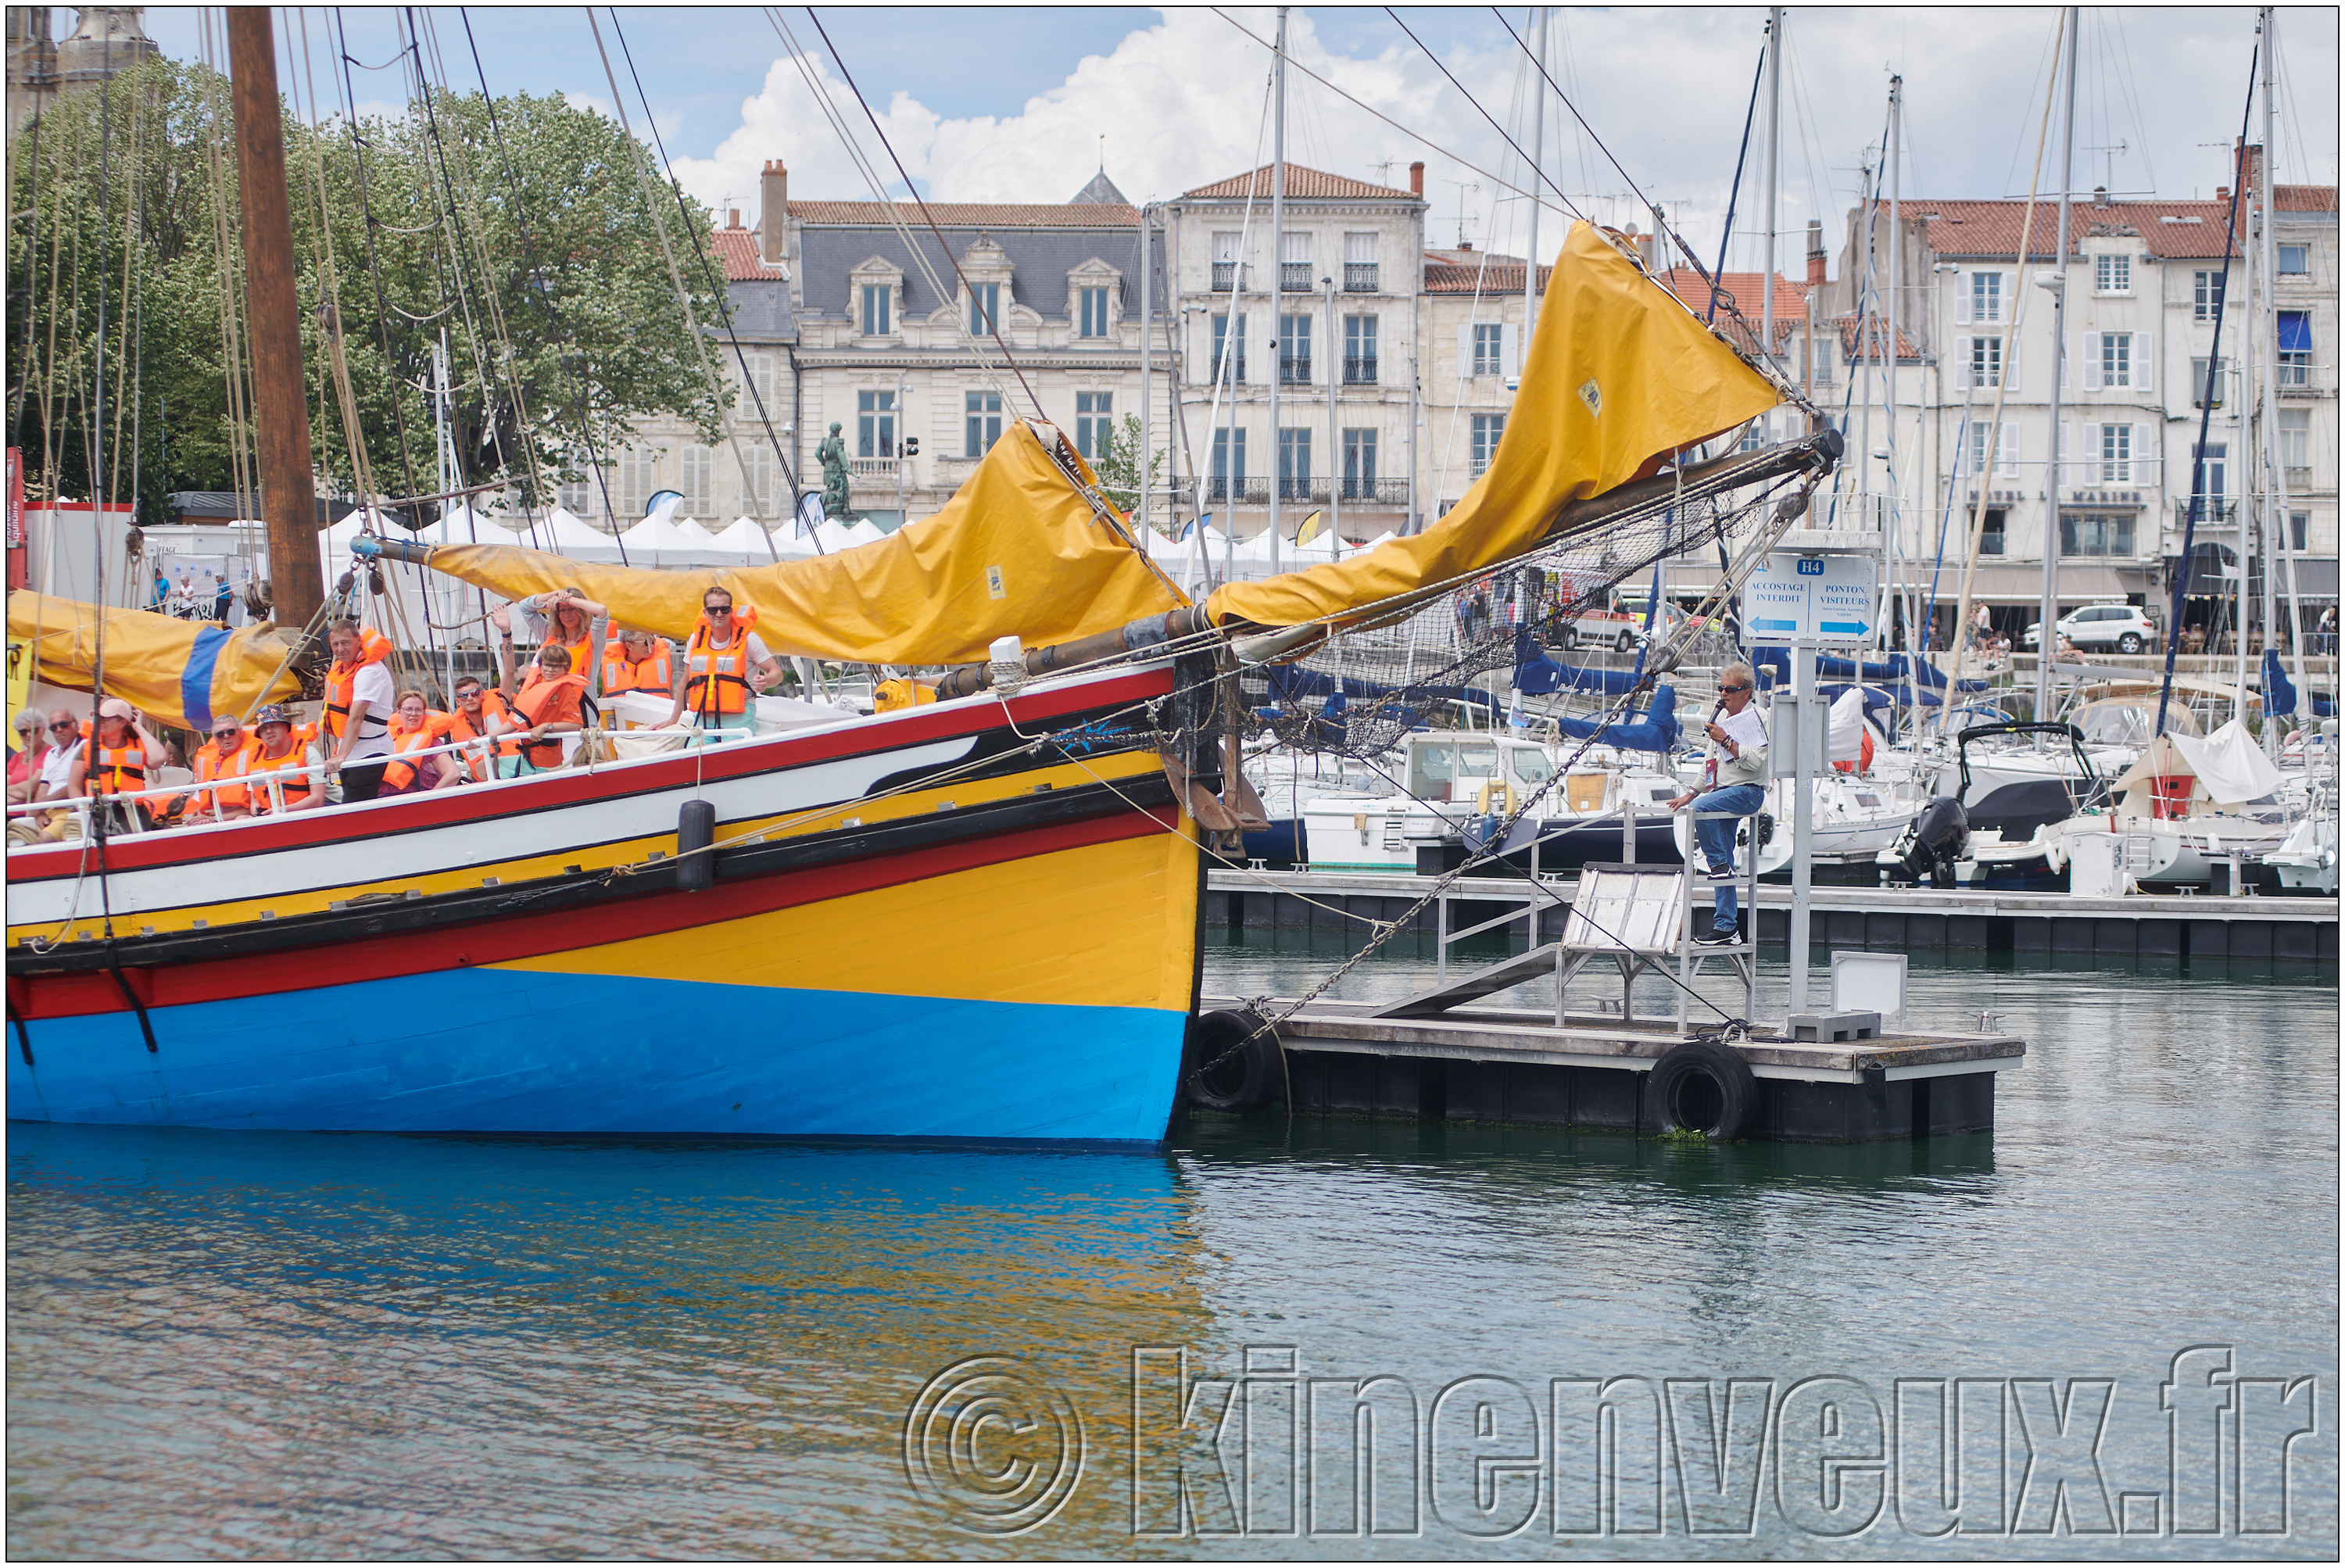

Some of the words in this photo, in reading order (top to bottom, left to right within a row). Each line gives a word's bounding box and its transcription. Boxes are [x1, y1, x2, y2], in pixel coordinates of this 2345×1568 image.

[1970, 490, 2025, 501] HTEL
[2073, 491, 2141, 502] MARINE
[12, 500, 22, 542] quitaine
[1802, 560, 1820, 573] H4
[1750, 582, 1806, 592] ACCOSTAGE
[1826, 585, 1865, 593] PONTON
[1756, 593, 1801, 603] INTERDIT
[1821, 596, 1870, 605] VISITEURS
